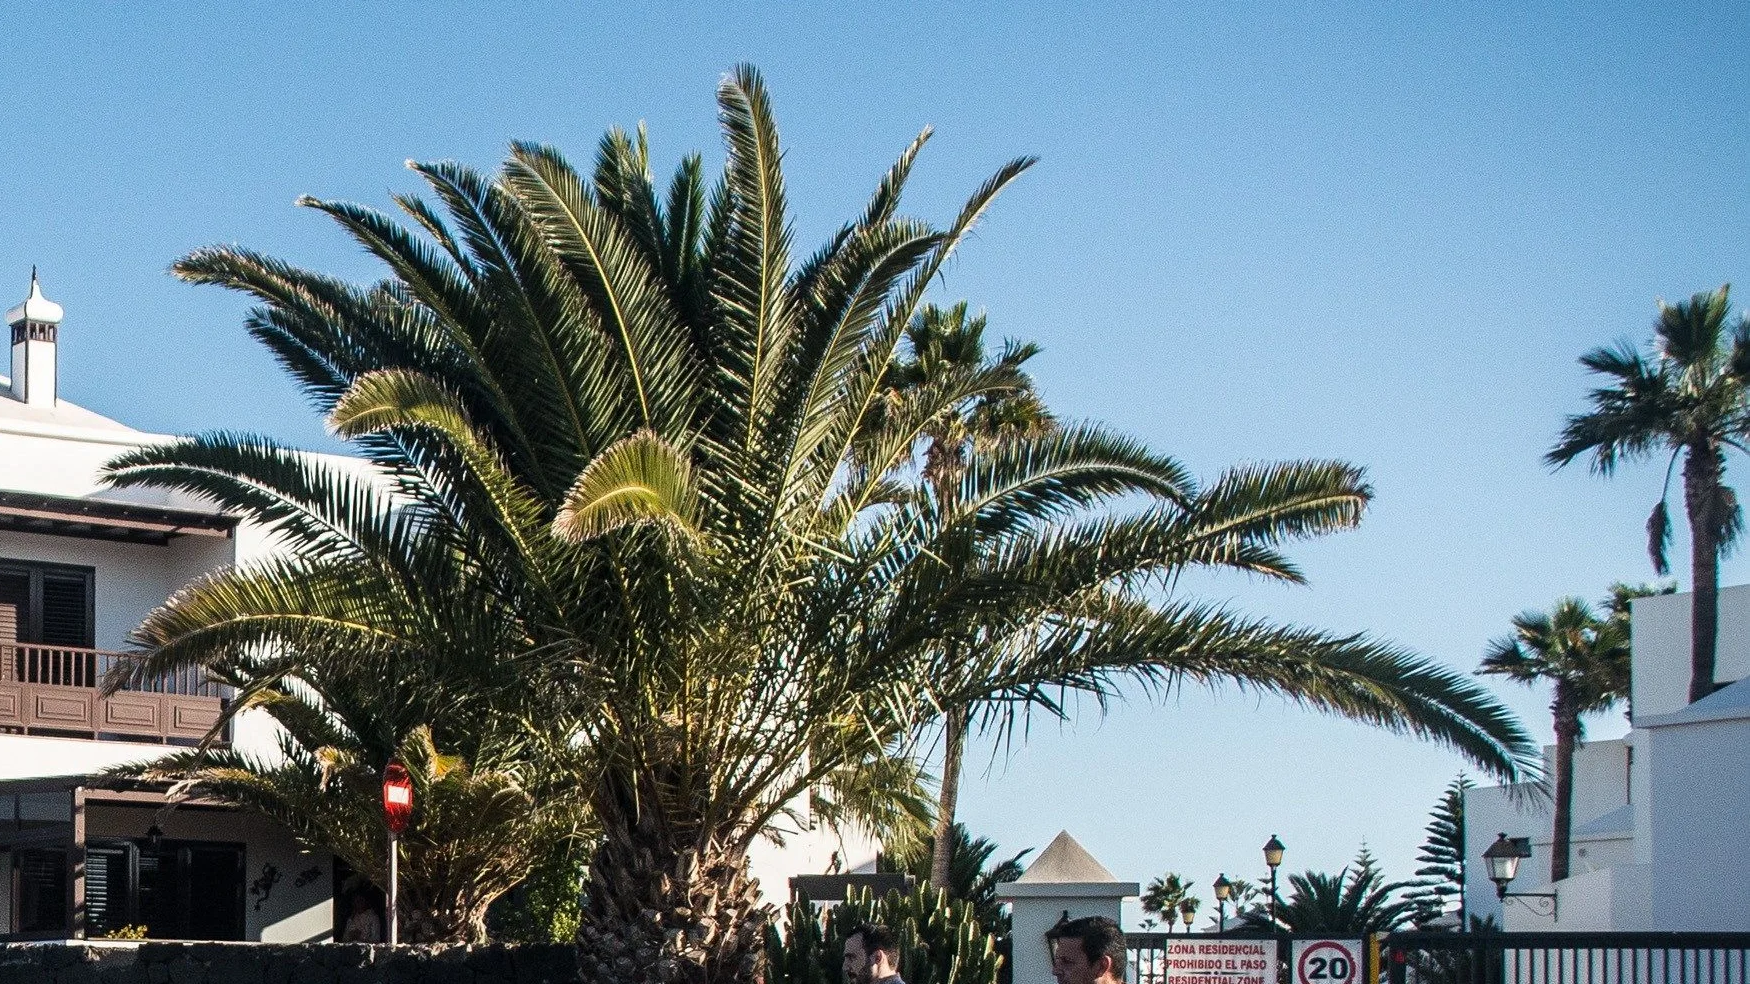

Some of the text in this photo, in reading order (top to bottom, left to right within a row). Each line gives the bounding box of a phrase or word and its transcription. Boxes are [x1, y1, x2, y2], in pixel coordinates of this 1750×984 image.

[1168, 944, 1266, 956] ZONA RESIDENCIAL
[1165, 959, 1267, 971] PROHIBIDO EL PASO
[1308, 957, 1349, 980] 20
